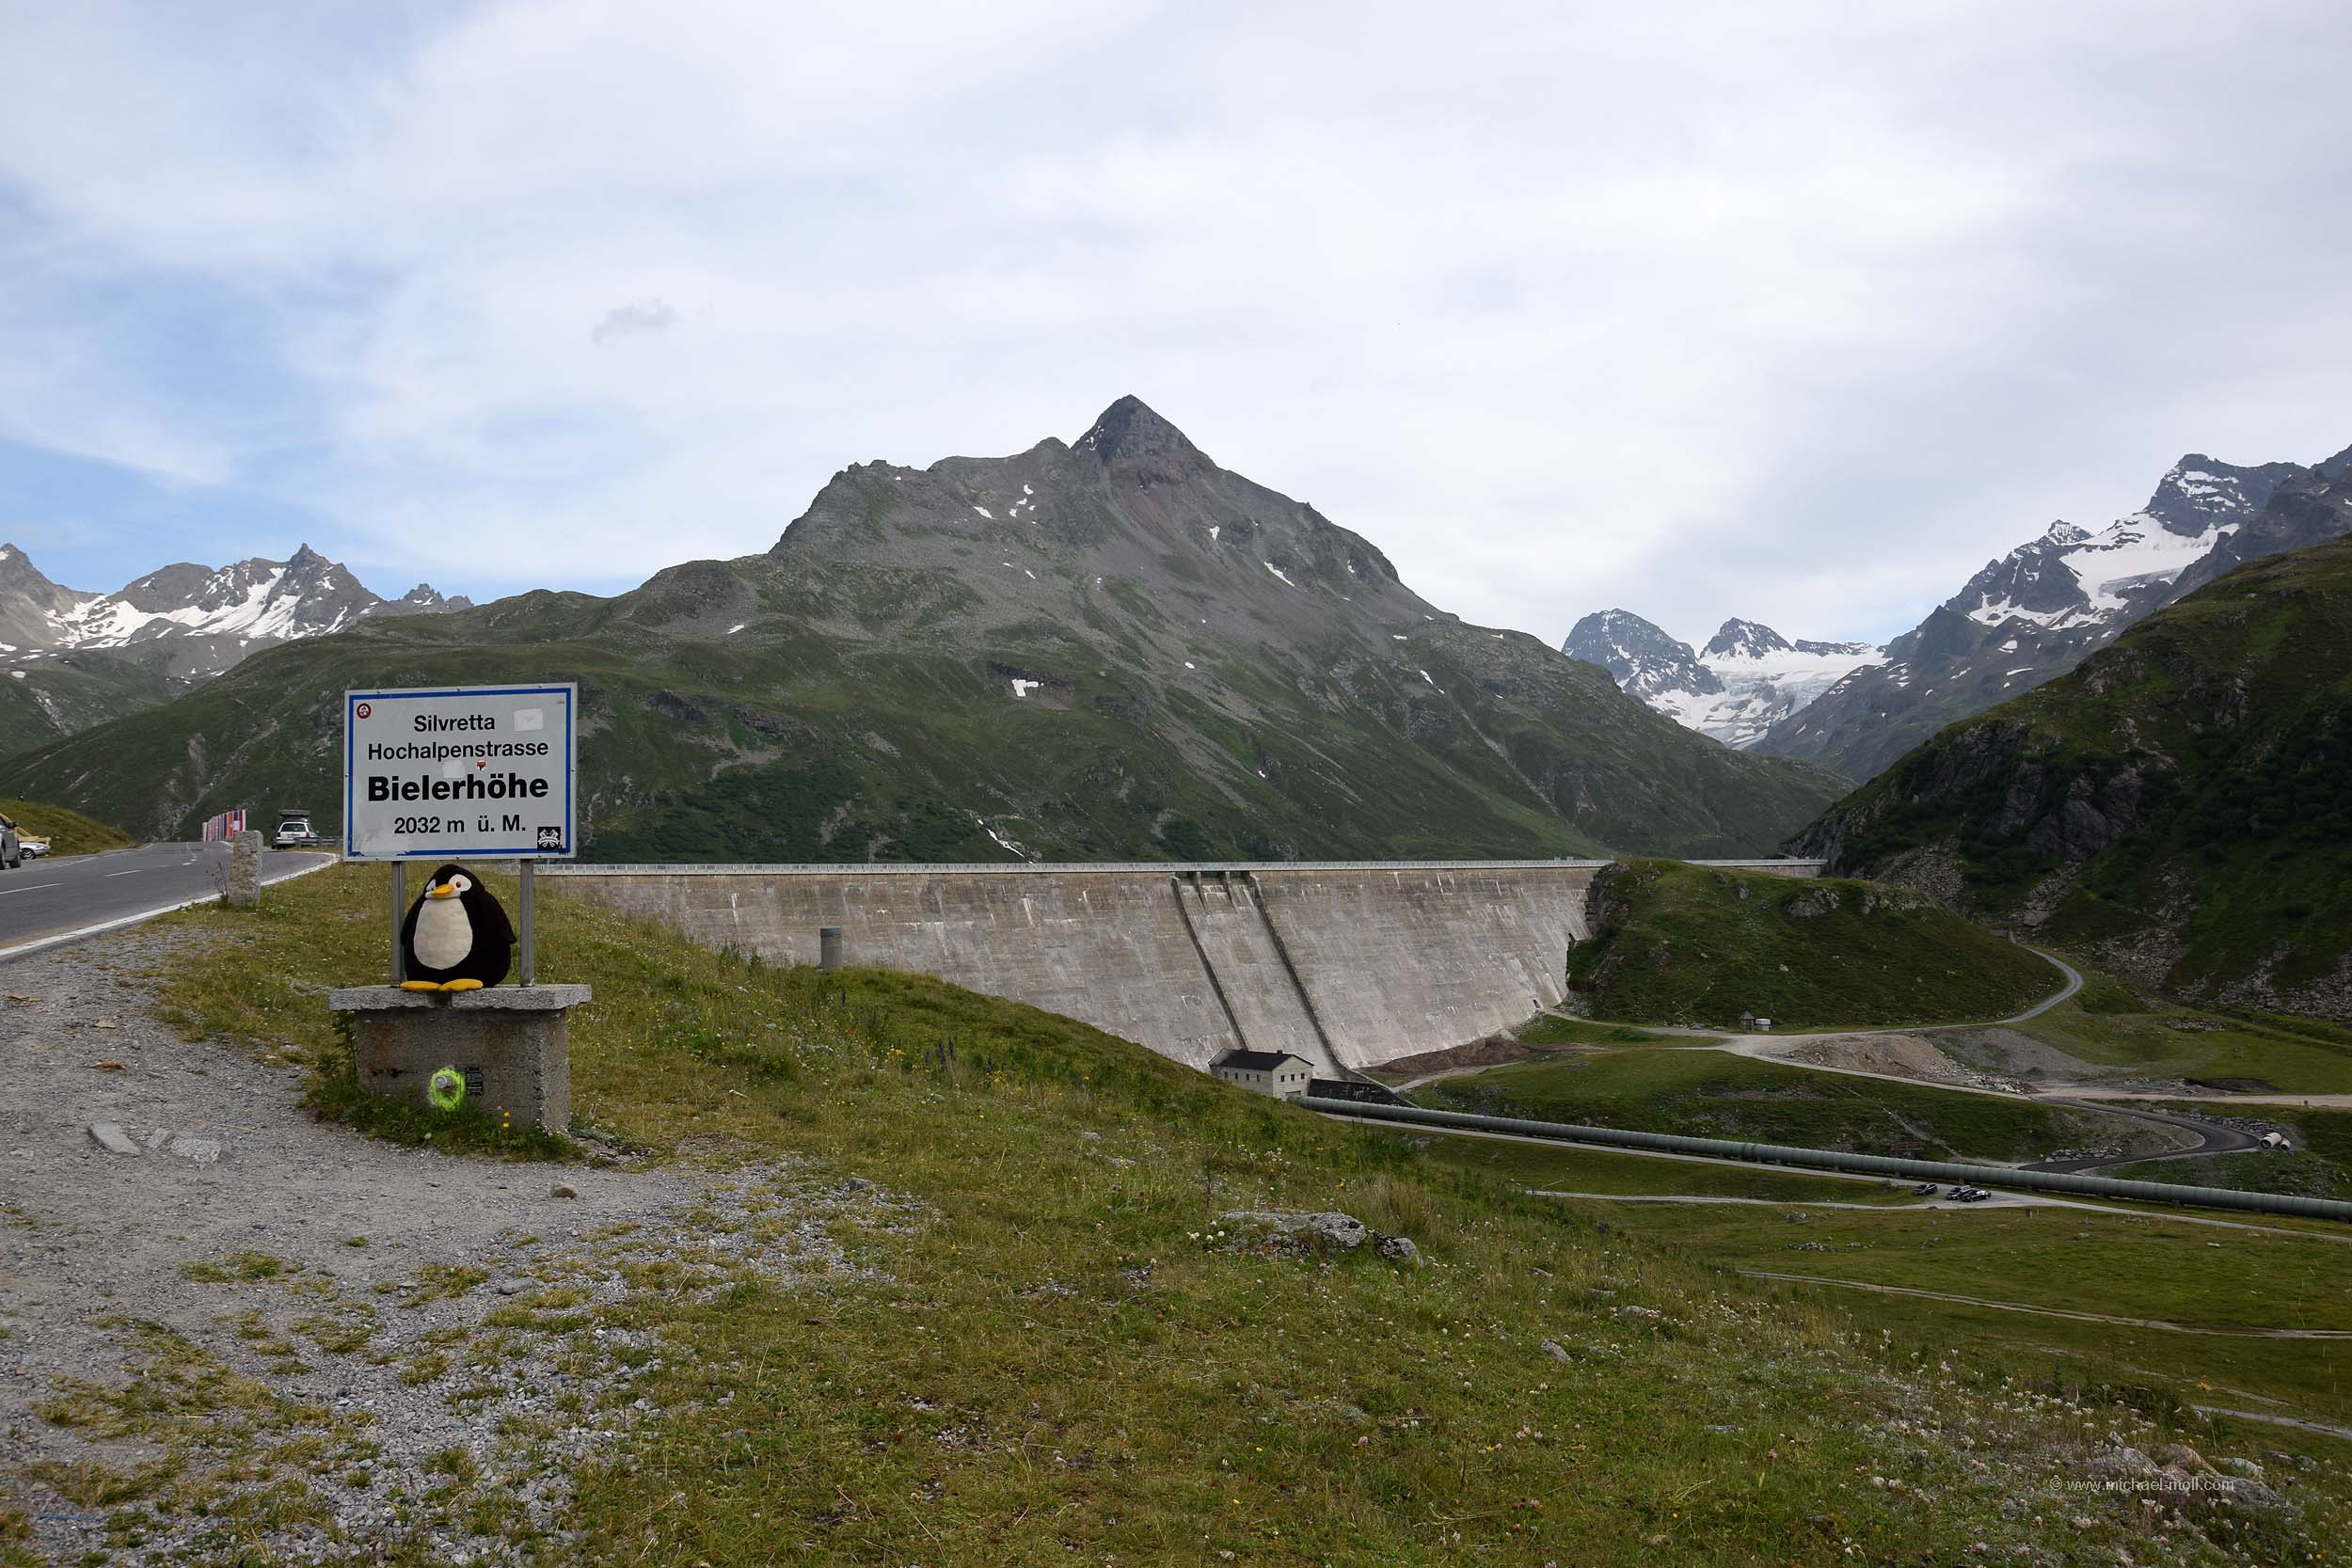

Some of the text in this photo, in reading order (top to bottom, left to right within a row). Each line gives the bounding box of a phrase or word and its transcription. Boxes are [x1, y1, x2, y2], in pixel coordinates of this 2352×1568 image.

[414, 715, 496, 733] Silvretta
[368, 741, 549, 762] Hochalpenstrasse
[368, 773, 549, 802] Bielerhöhe
[393, 815, 527, 834] 2032 m ü. M.
